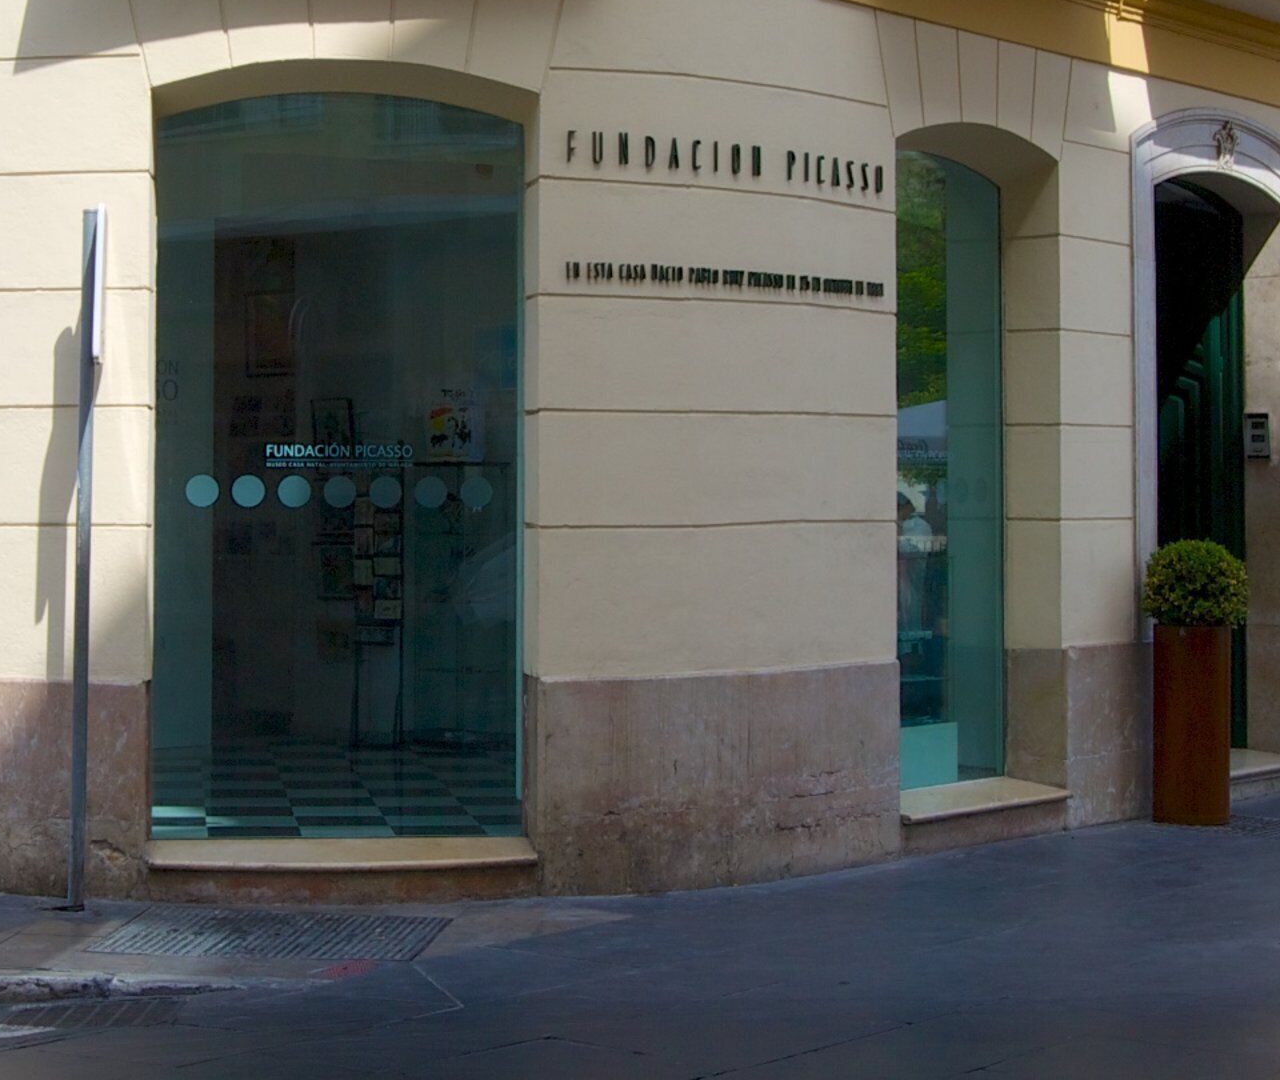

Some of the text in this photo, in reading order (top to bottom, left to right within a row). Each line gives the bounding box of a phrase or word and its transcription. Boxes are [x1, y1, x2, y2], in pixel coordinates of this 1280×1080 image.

[787, 150, 883, 194] PICASSO
[587, 262, 613, 281] ESTA
[619, 263, 646, 281] CASA
[689, 267, 719, 284] PABLO
[748, 271, 783, 288] PICASSO
[266, 442, 413, 457] FUNDACIÓN PICASSO
